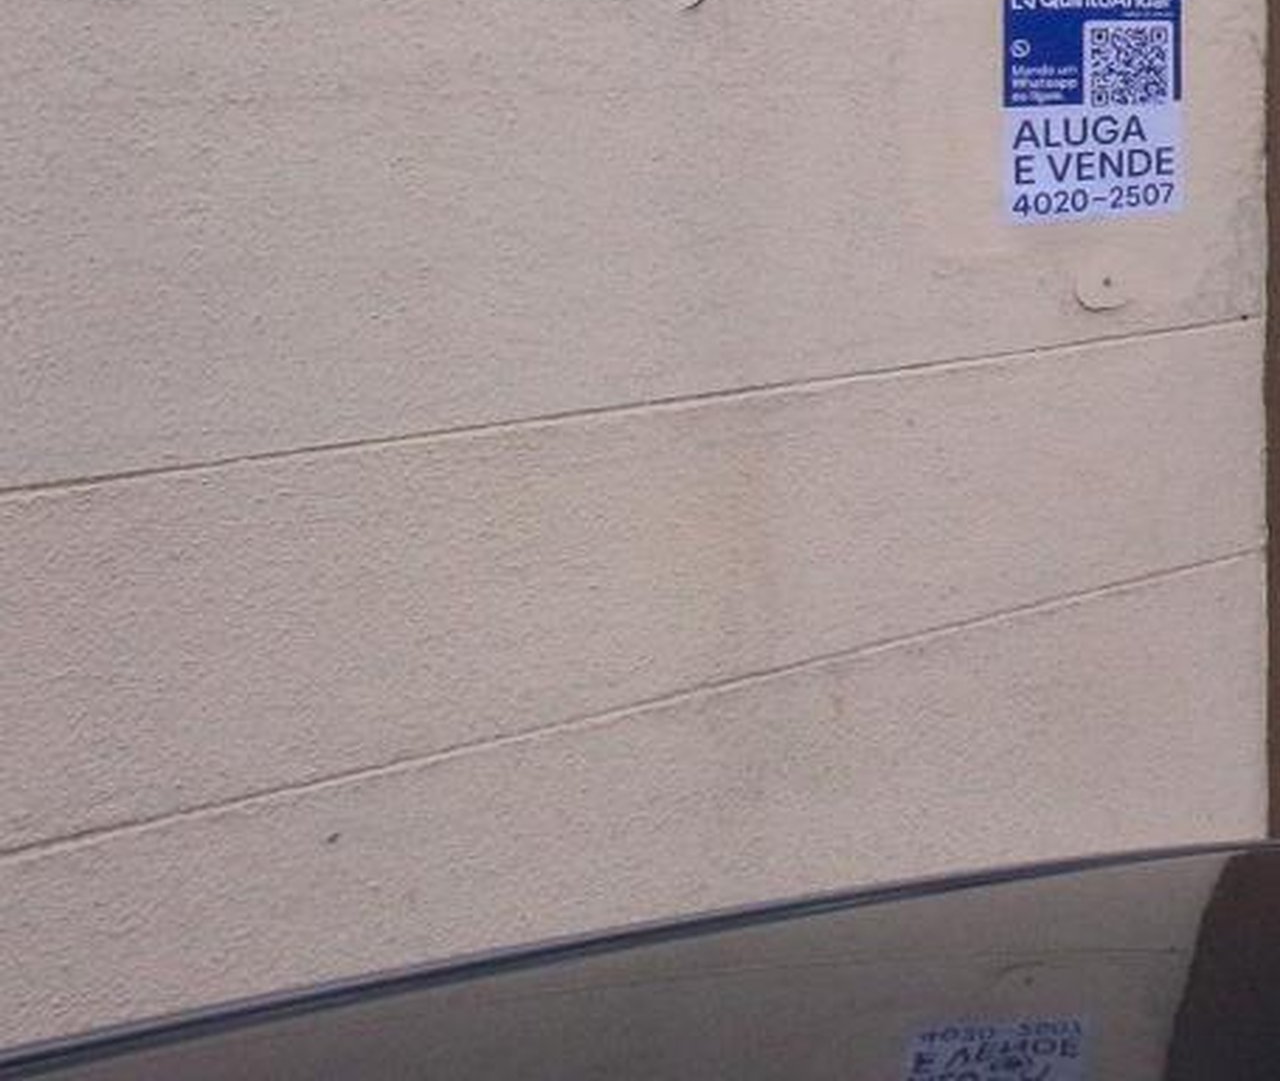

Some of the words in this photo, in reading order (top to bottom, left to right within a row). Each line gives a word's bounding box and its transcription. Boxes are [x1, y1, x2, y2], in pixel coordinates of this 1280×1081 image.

[1012, 115, 1147, 150] ALUGA
[1014, 155, 1036, 185] E
[1046, 146, 1175, 183] VENDE
[1012, 182, 1175, 217] 4020-2507
